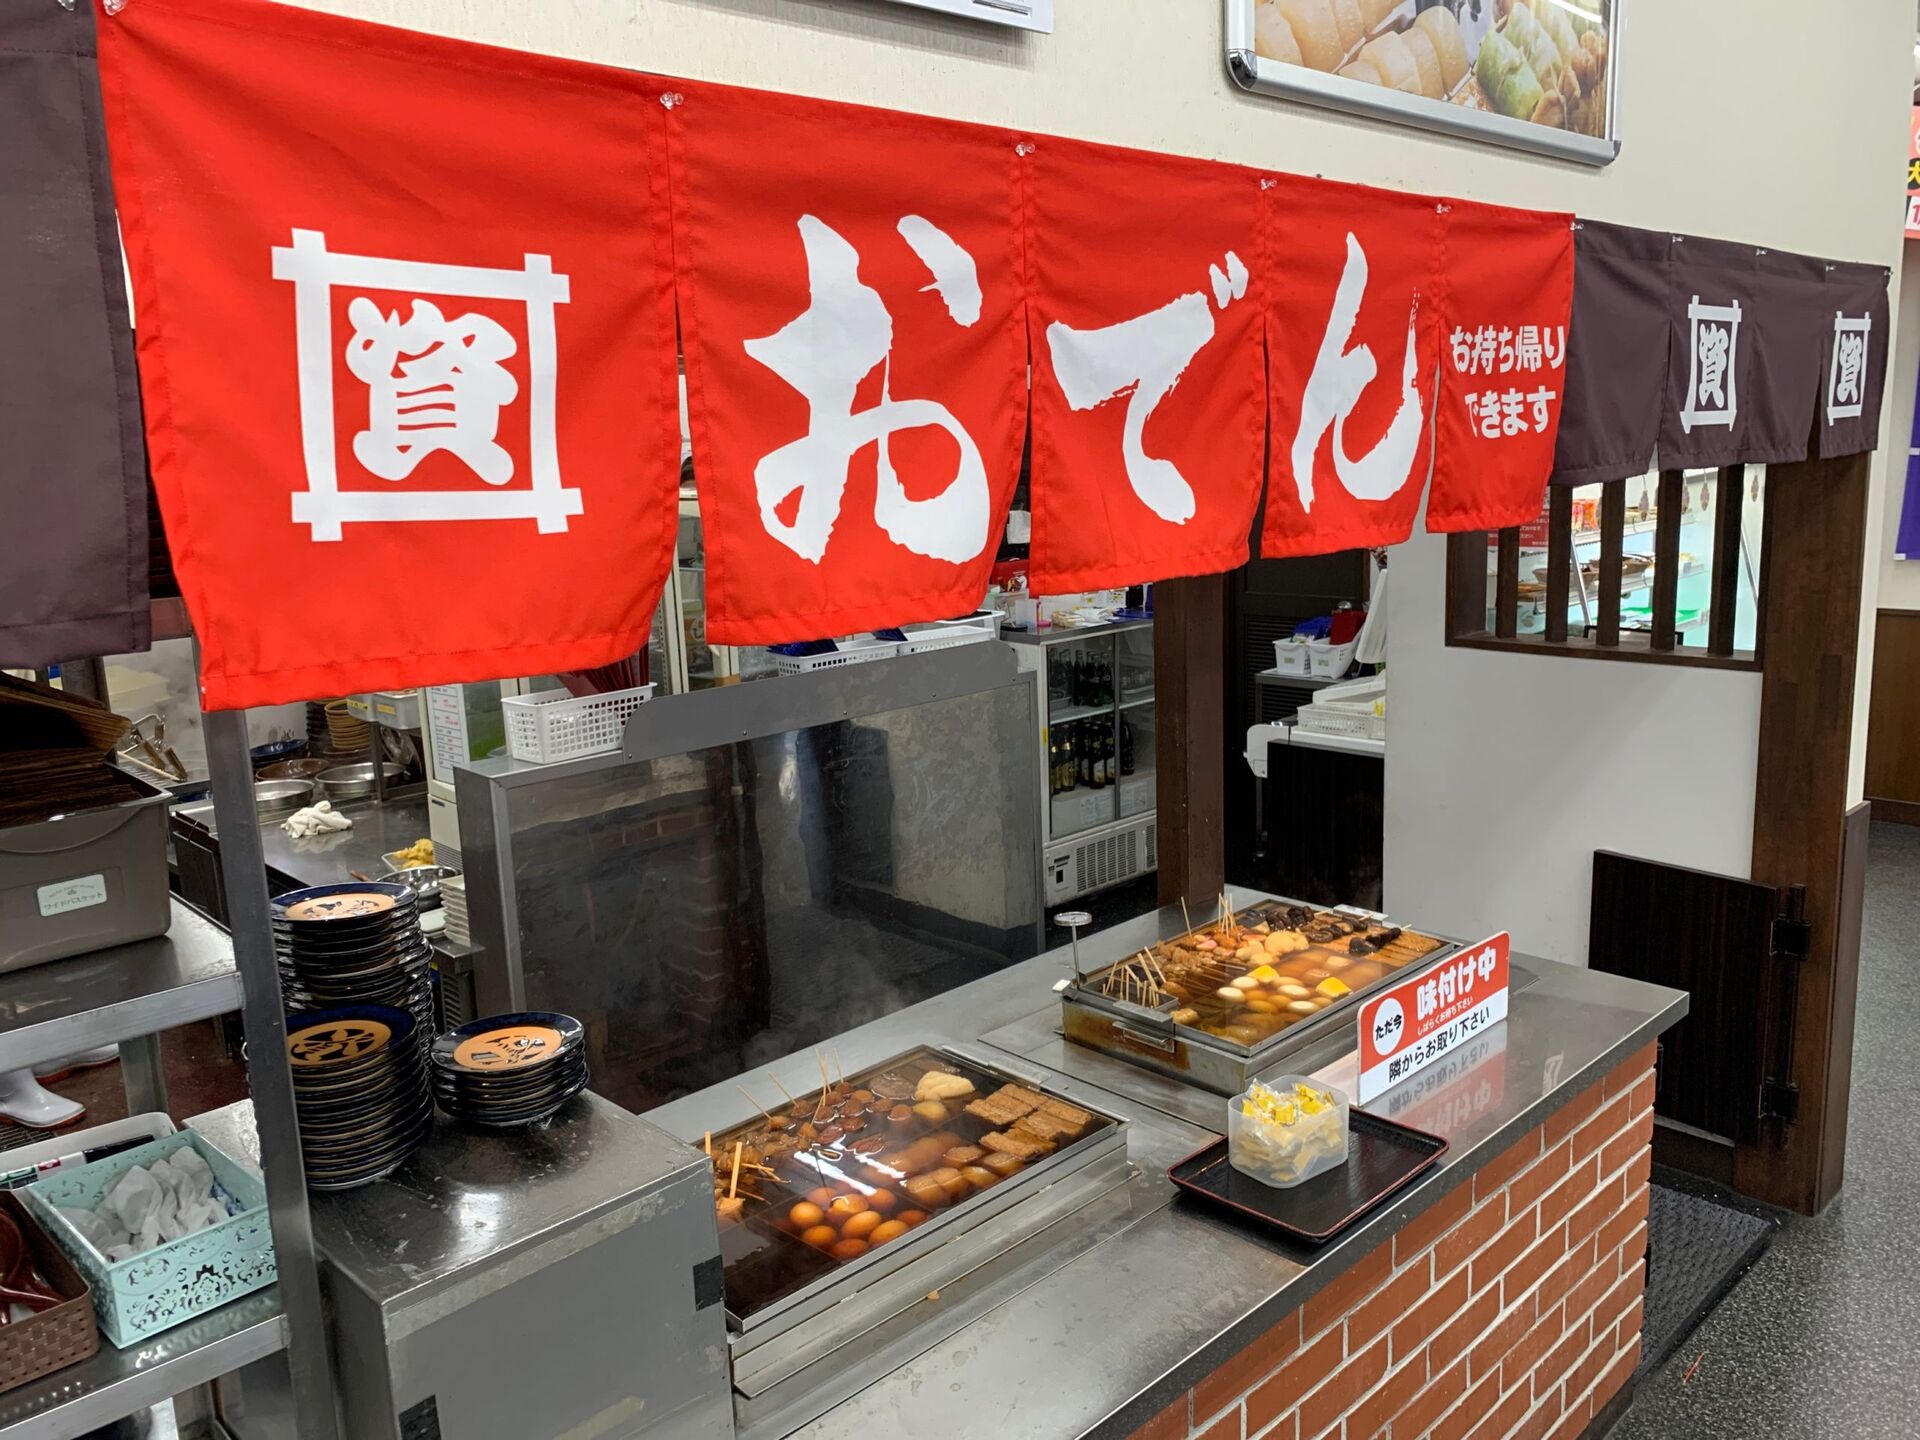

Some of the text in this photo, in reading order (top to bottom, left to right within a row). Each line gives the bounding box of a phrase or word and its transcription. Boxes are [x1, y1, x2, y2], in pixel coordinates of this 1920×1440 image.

[1450, 325, 1565, 374] お持ち帰り
[744, 214, 1423, 565] おでん
[1464, 385, 1556, 439] できます
[1416, 946, 1497, 1021] 味付け中
[1375, 1014, 1402, 1041] ただ今
[1388, 1006, 1490, 1083] 隣からお取り下さい
